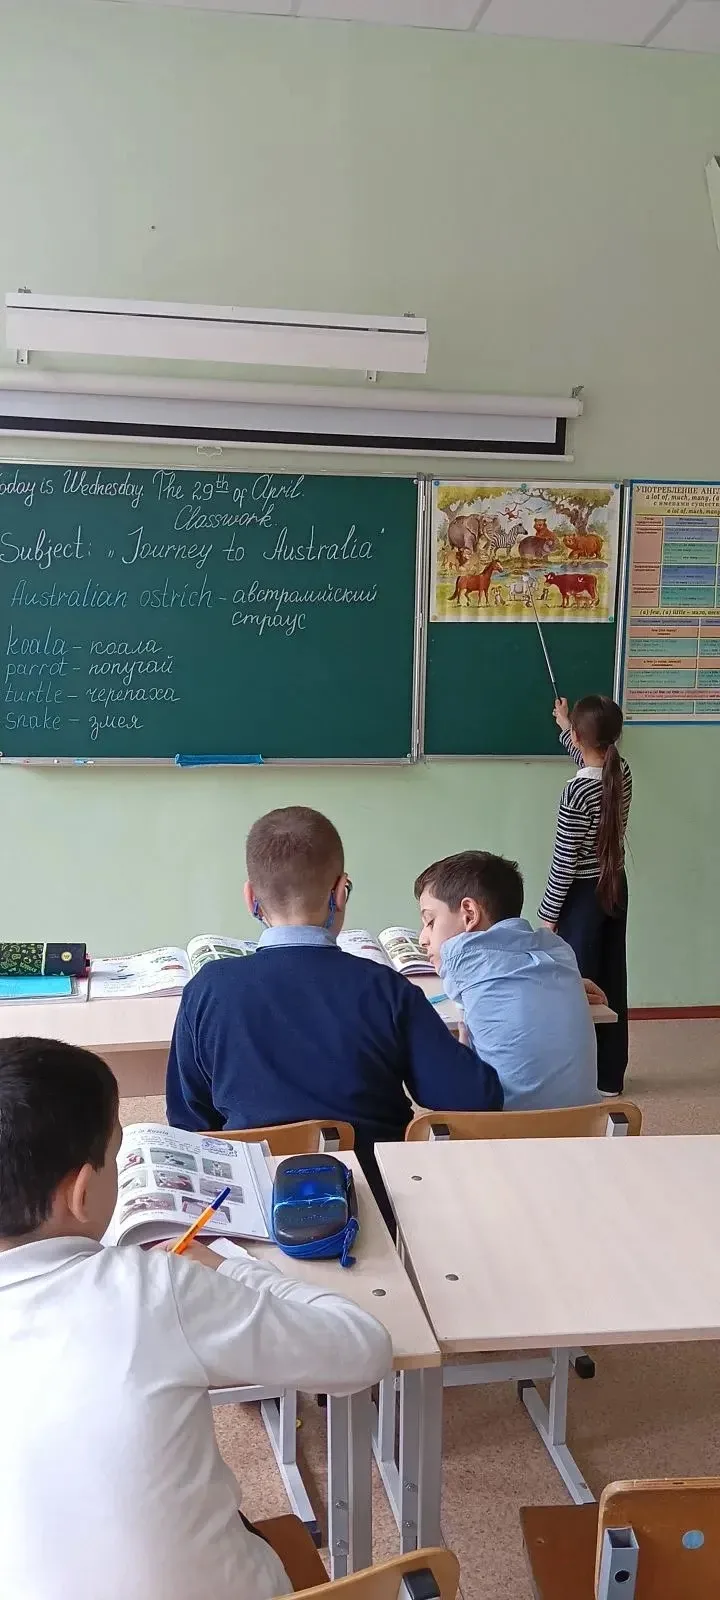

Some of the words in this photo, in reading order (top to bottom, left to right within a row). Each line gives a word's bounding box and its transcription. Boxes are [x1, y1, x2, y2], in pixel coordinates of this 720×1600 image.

[40, 478, 54, 494] is
[63, 469, 144, 508] Wednesday.
[152, 469, 185, 500] The
[233, 486, 248, 508] of
[252, 474, 305, 511] April.
[636, 486, 698, 494] УПОТРЕБЛЕНИЕ
[0, 526, 92, 569] Subject:
[223, 532, 245, 561] to
[11, 578, 128, 608] Australian
[140, 574, 213, 608] ostrich
[231, 611, 306, 636] страус
[6, 625, 68, 656] koala
[89, 639, 162, 655] коала
[5, 657, 69, 684] parrot
[4, 681, 64, 704] turtle
[86, 687, 181, 708] черепаха
[88, 715, 144, 740] змея
